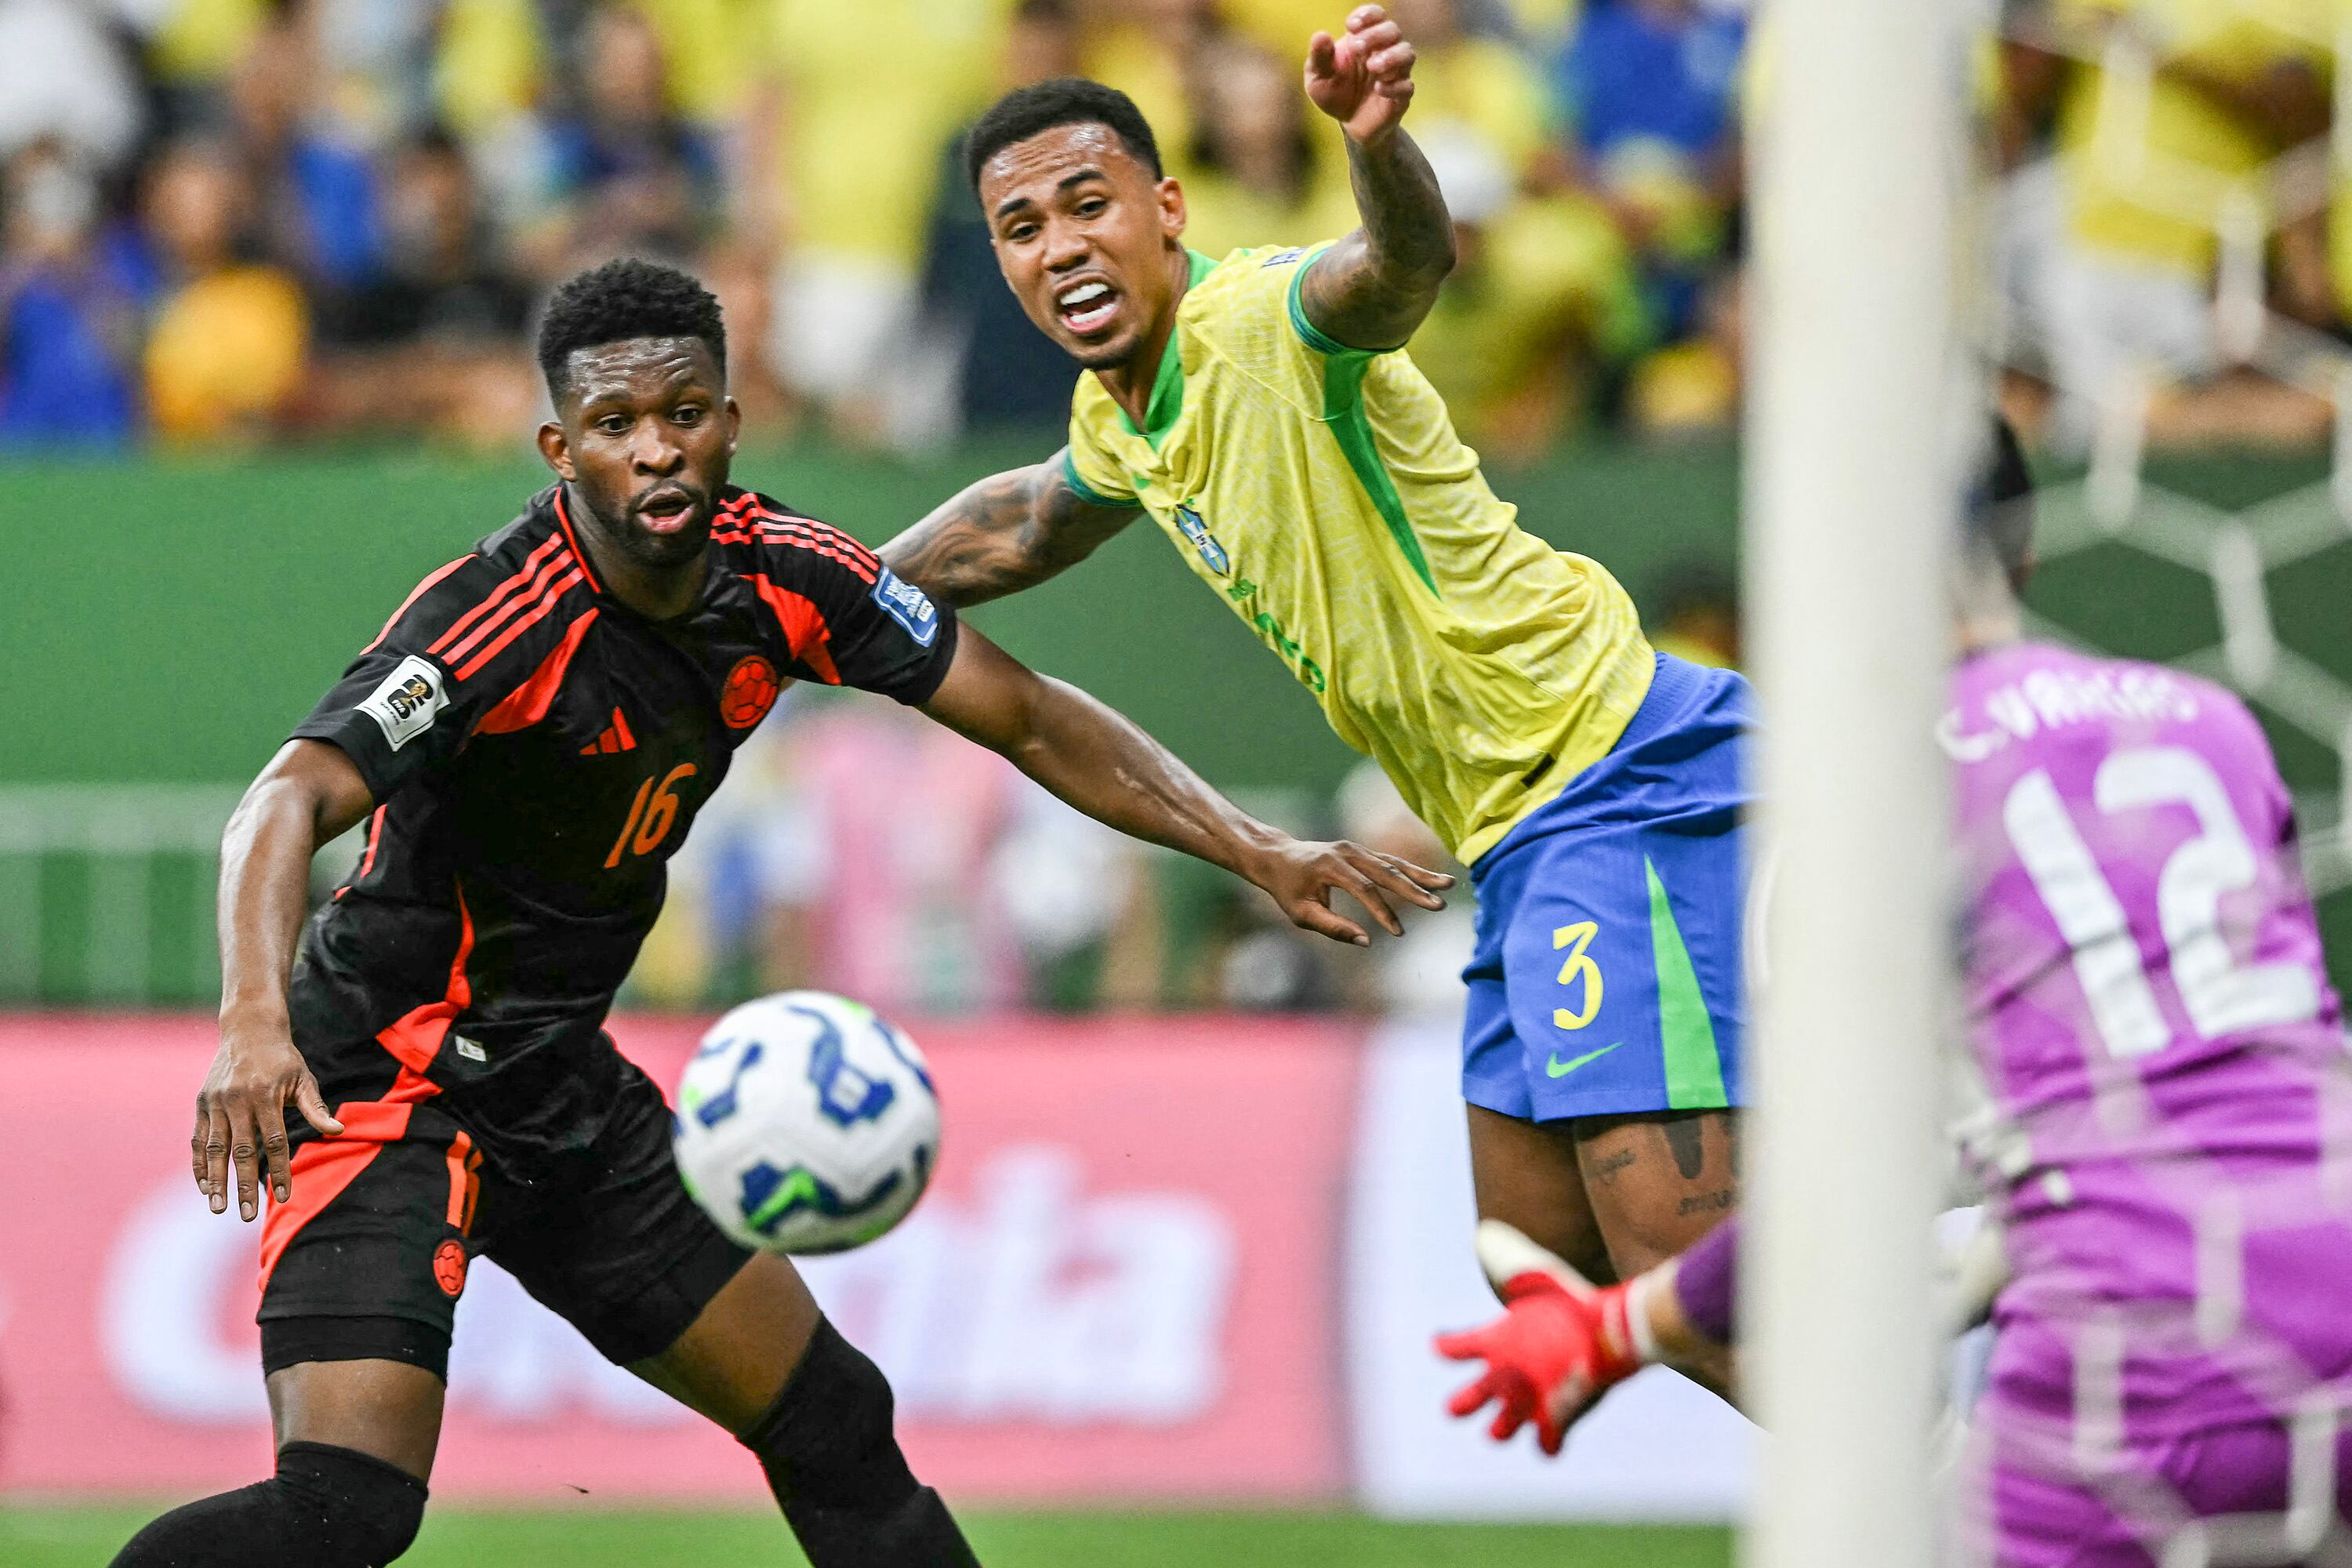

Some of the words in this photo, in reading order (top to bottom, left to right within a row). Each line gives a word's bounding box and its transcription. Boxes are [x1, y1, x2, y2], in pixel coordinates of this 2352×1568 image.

[602, 762, 698, 869] 16
[2002, 745, 2321, 1058] 12
[1552, 920, 1604, 1031] 3
